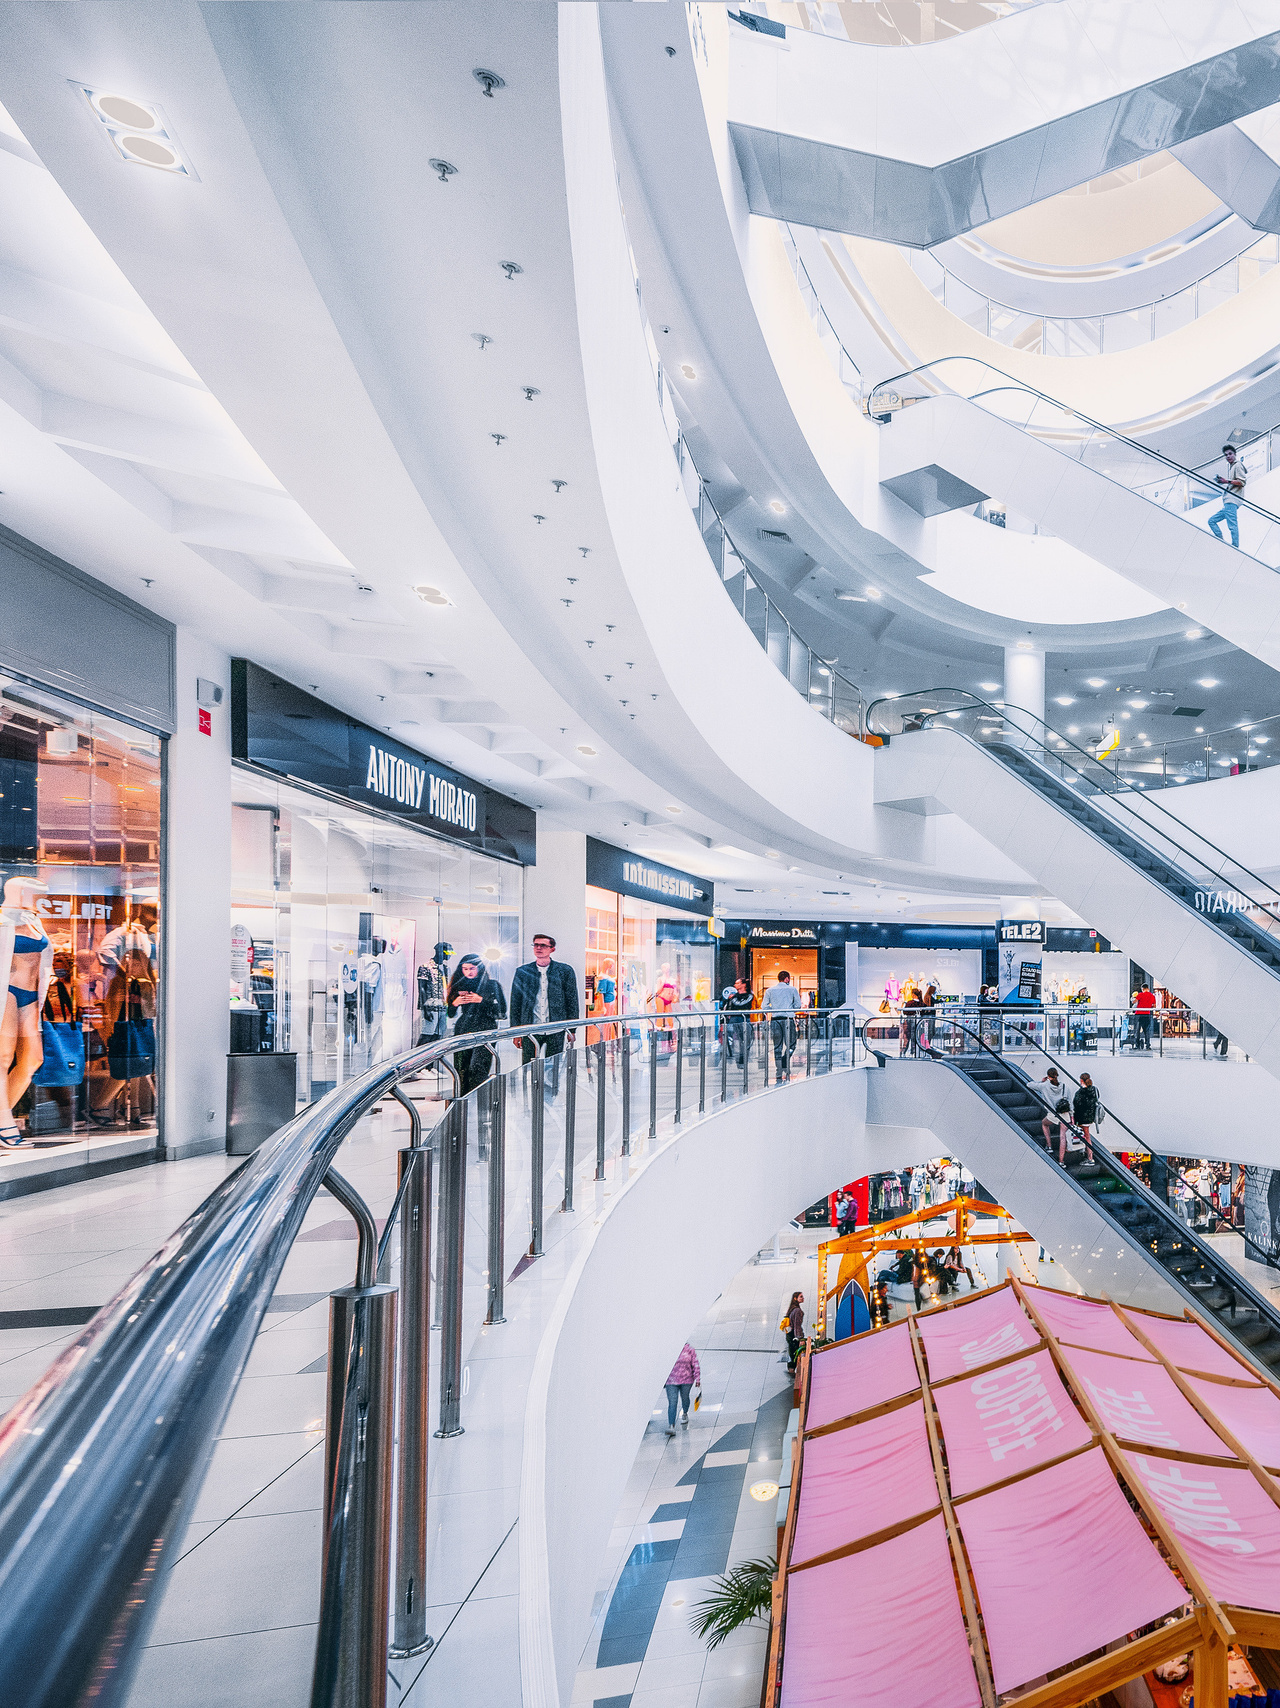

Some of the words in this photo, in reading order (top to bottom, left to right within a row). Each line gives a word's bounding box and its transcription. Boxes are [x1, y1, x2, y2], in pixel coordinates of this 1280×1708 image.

[366, 745, 425, 809] ANTONY
[429, 774, 476, 832] MORATO
[752, 927, 791, 937] Massimo
[791, 928, 816, 938] Dutti
[1001, 922, 1041, 940] TELE2
[971, 1360, 1064, 1461] COFFEE
[1083, 1376, 1180, 1447] OFFEE
[1136, 1456, 1256, 1554] SURF
